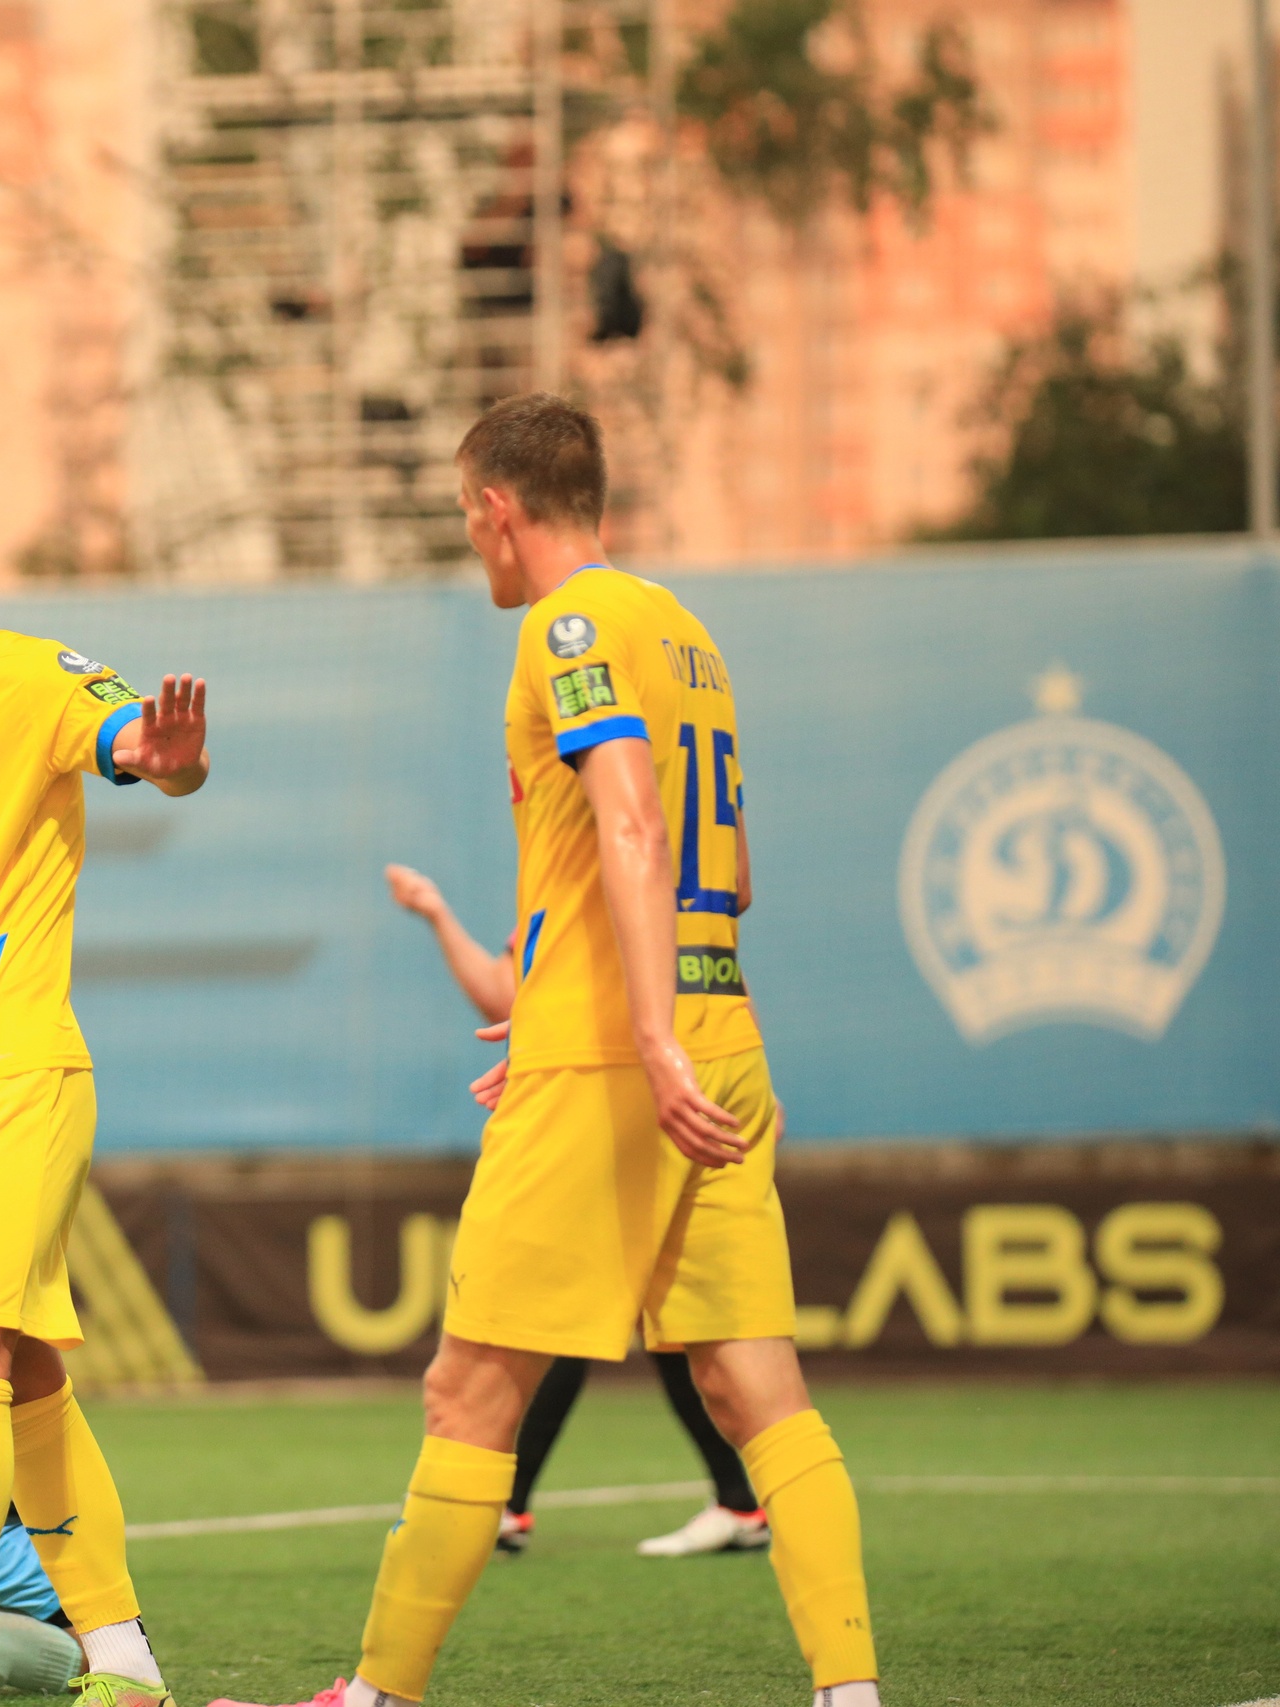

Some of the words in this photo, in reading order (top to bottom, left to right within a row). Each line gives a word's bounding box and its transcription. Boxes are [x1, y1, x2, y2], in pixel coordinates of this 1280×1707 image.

[90, 677, 129, 697] BET
[555, 666, 606, 696] BET
[560, 685, 613, 715] ERA
